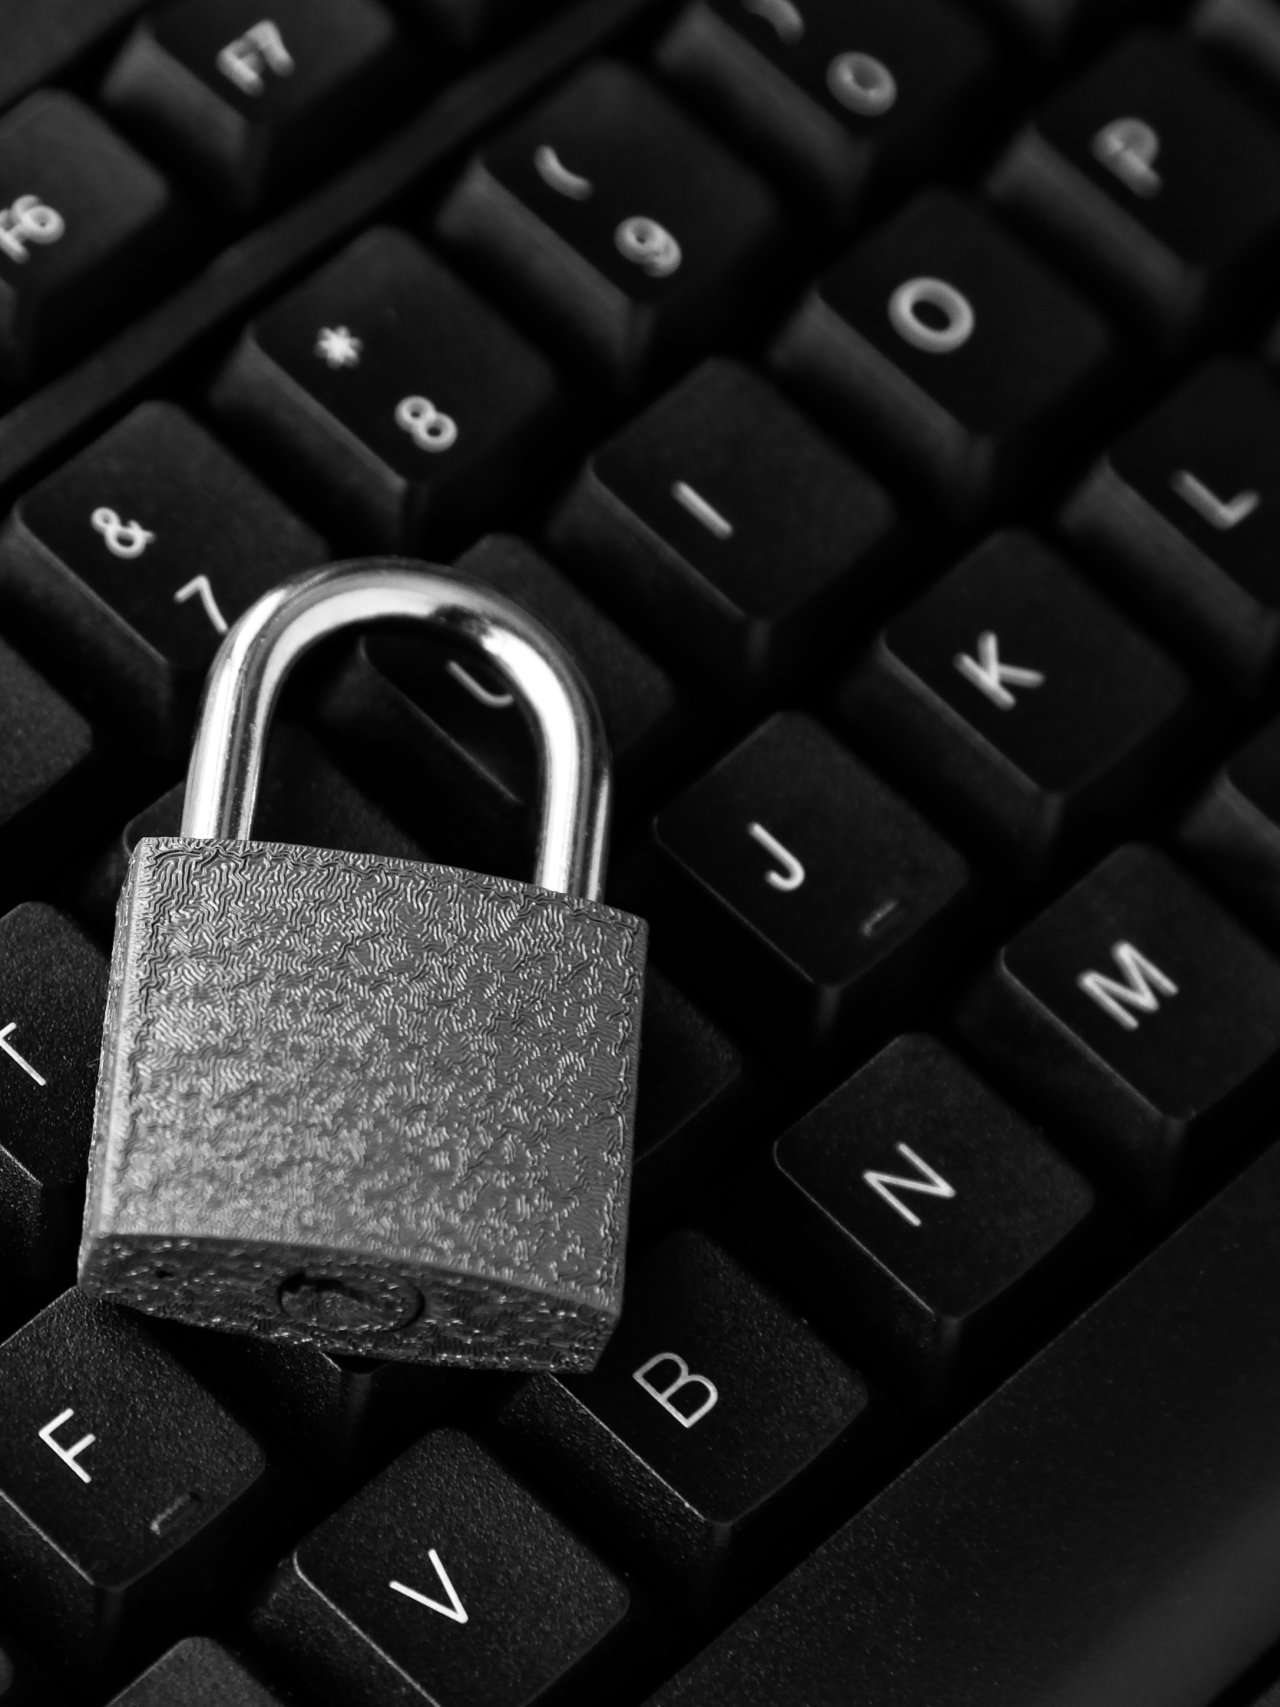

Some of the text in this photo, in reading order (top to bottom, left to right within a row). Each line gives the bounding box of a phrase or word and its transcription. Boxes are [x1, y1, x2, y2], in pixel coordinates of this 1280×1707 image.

[218, 20, 294, 94] F7
[1093, 118, 1161, 196] P
[615, 216, 681, 277] 9
[394, 395, 458, 452] 8
[90, 506, 155, 559] &
[1171, 470, 1259, 530] L
[174, 574, 228, 634] 7
[955, 631, 1045, 709] K
[748, 821, 807, 893] J
[1076, 940, 1180, 1031] M
[862, 1142, 957, 1227] N
[632, 1352, 720, 1429] B
[37, 1407, 97, 1484] F
[388, 1548, 469, 1625] V
